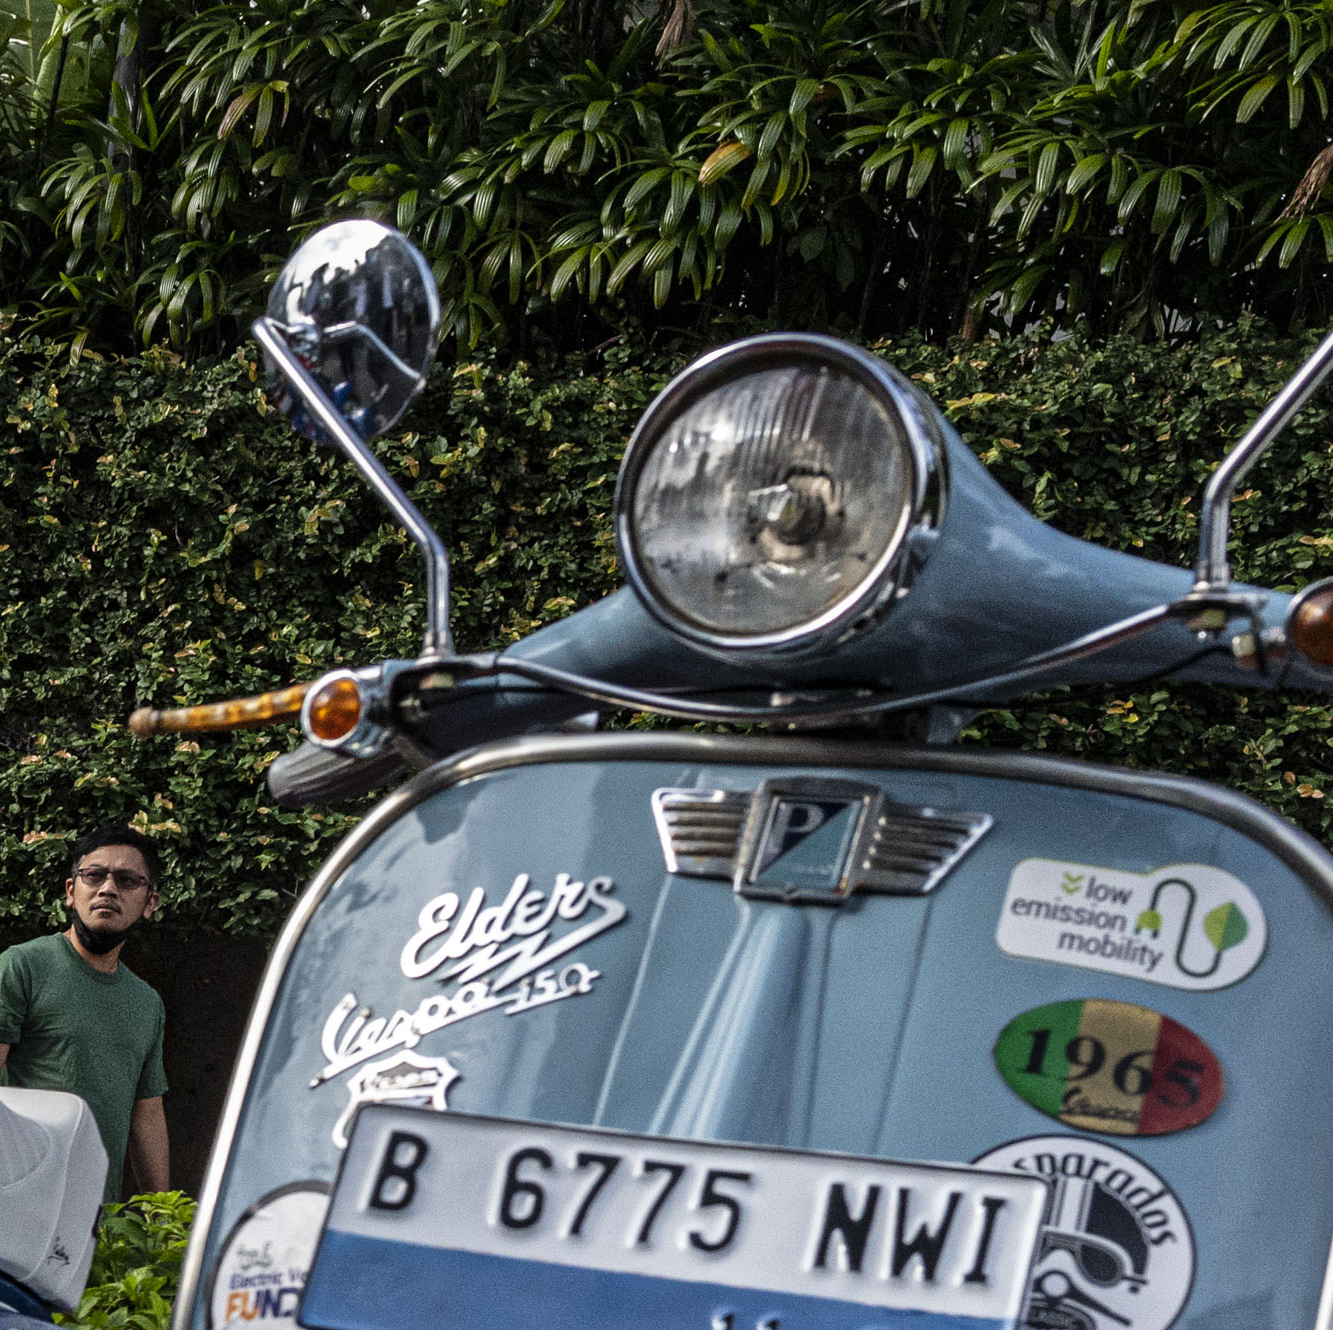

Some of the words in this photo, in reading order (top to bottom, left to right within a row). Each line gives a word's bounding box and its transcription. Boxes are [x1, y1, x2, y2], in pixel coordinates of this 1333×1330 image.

[1010, 897, 1128, 932] emission
[1085, 875, 1133, 905] low
[400, 872, 627, 992] Elders
[1057, 930, 1165, 973] mobility
[309, 980, 505, 1088] Vespa
[1017, 1028, 1206, 1108] 1965
[366, 1129, 428, 1212] B
[496, 1146, 753, 1253] 6775
[811, 1181, 1008, 1286] NWI
[224, 1286, 301, 1322] FUND
